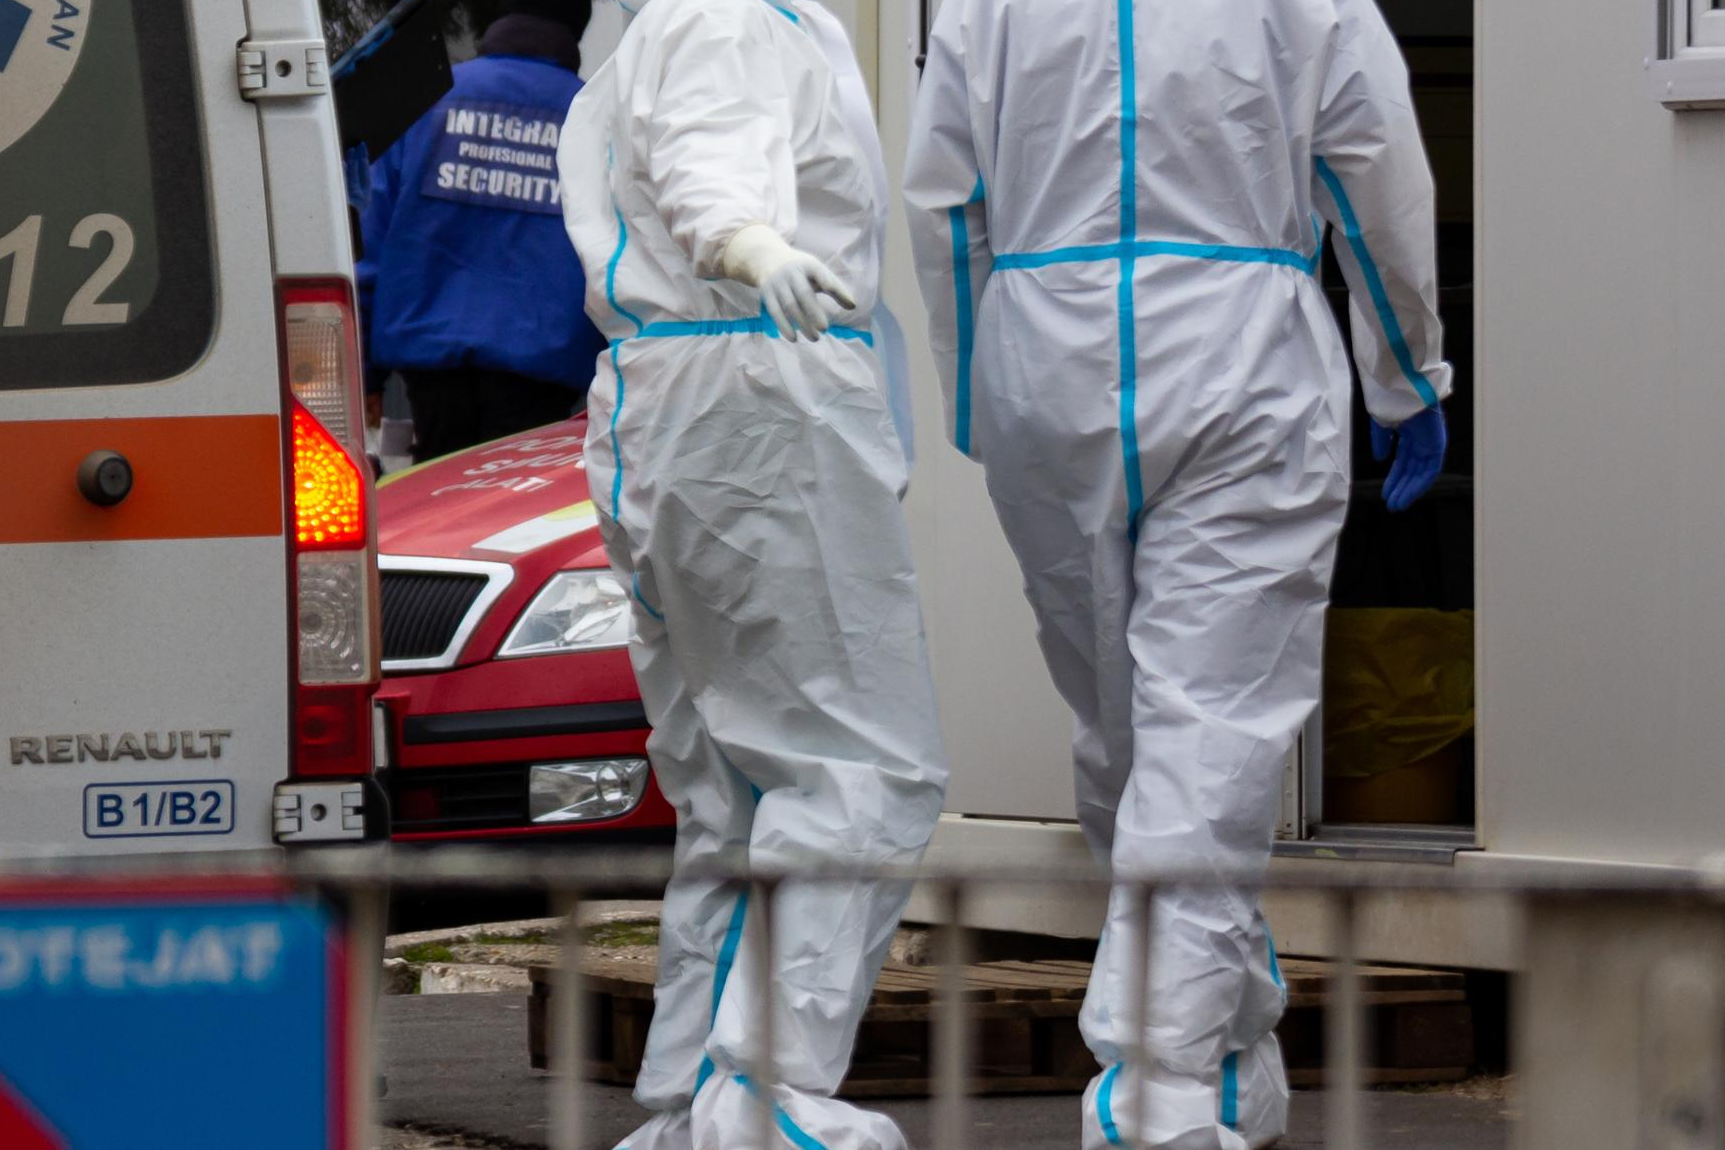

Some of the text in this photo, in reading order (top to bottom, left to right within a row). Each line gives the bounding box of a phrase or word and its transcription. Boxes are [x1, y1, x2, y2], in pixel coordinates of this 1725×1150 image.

[458, 141, 553, 170] PROFESIONAL
[437, 161, 561, 205] SECURITY
[9, 729, 233, 765] RENAULT
